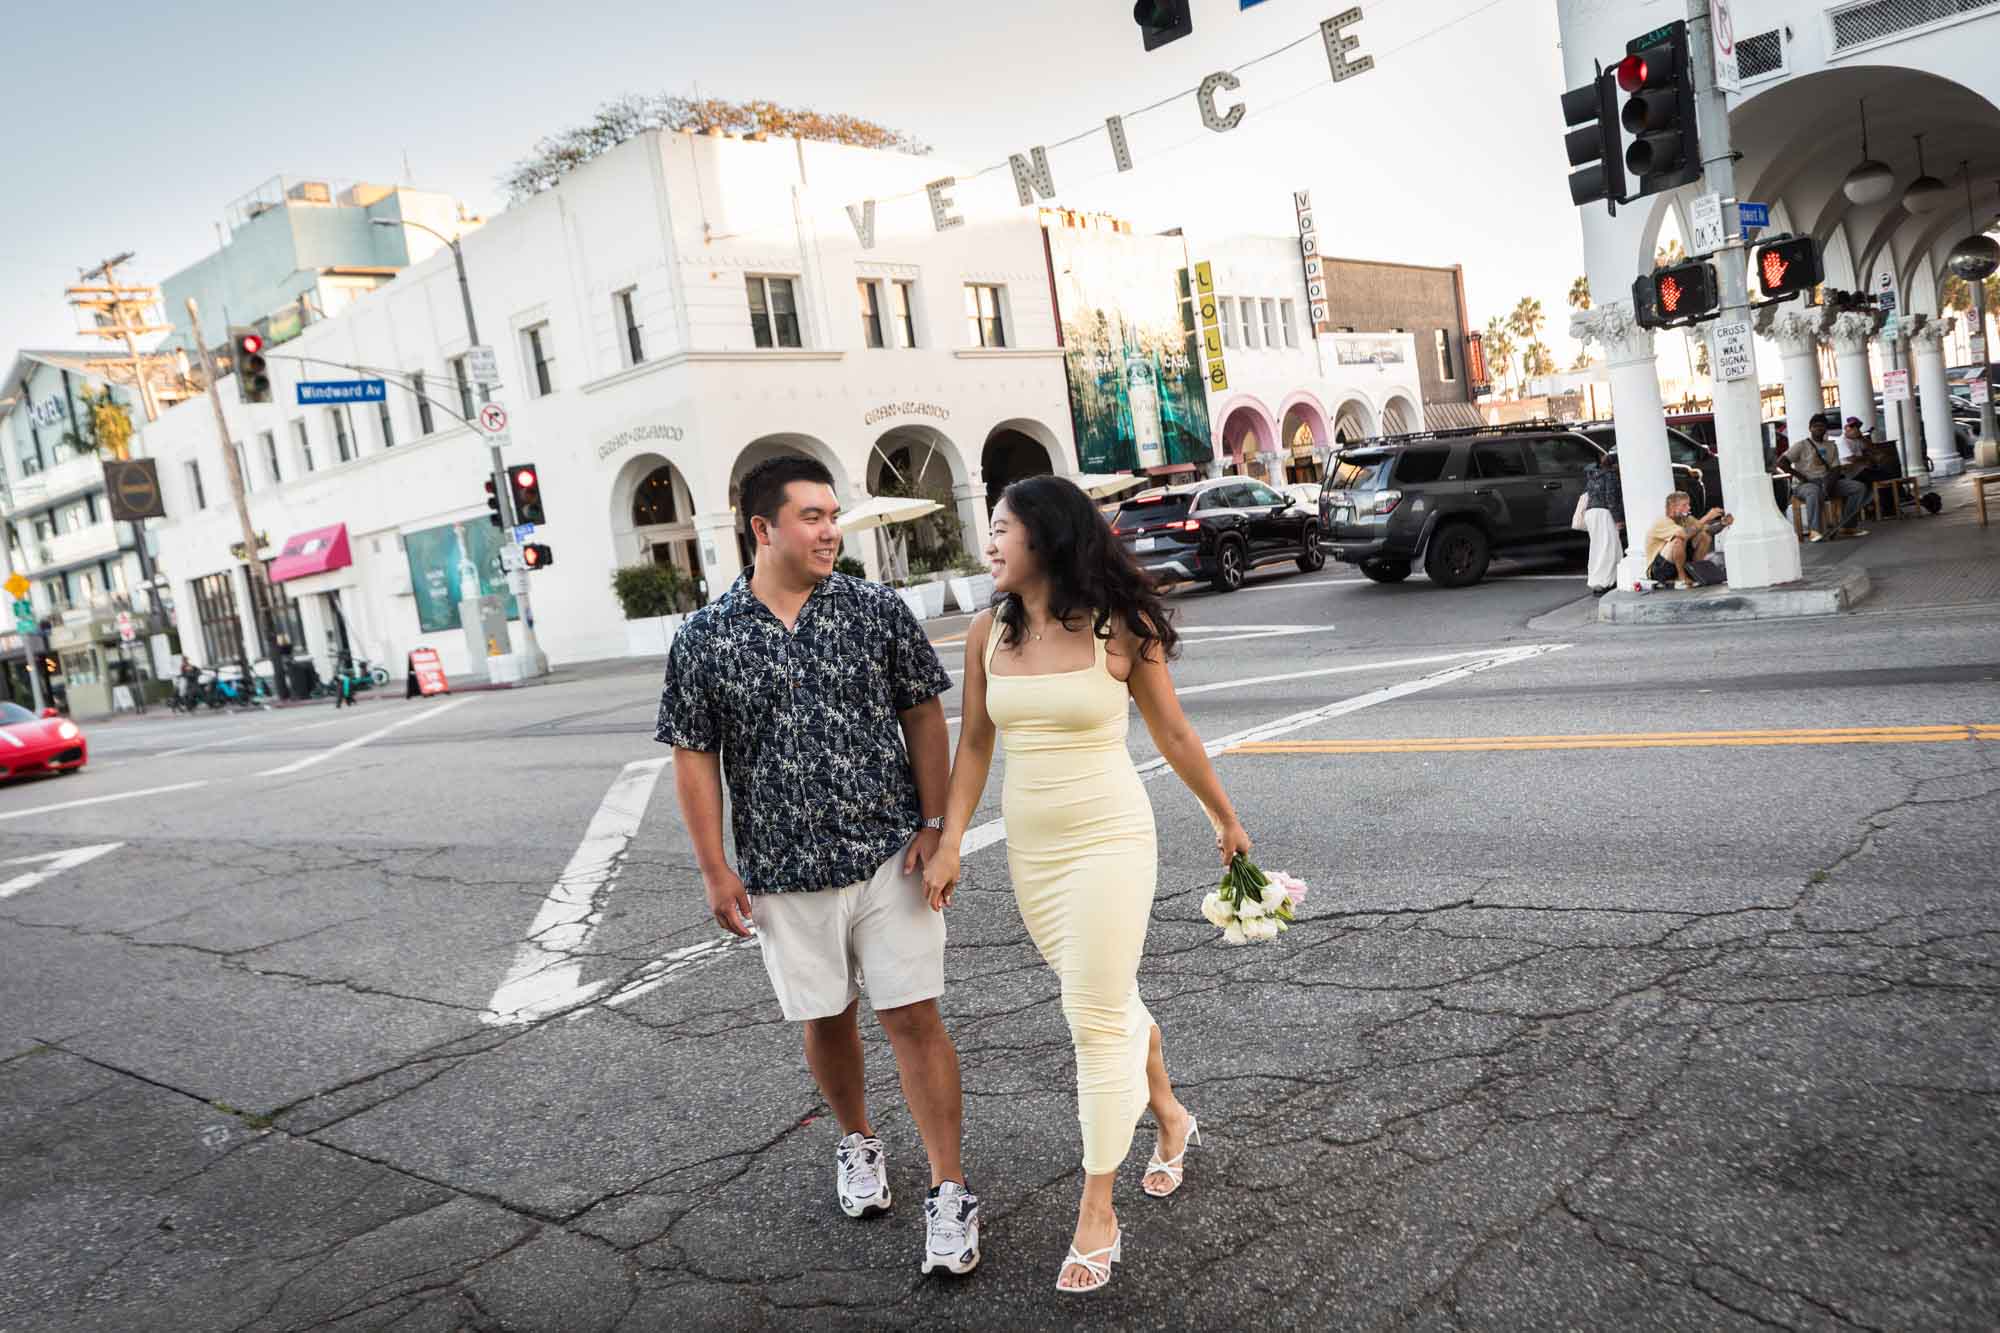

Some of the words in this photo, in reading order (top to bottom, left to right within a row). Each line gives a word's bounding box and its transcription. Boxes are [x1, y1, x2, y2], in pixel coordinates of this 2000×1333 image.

[845, 6, 1375, 248] VENICE
[1299, 193, 1323, 319] VOODOO
[1717, 324, 1745, 337] CROSS
[1728, 337, 1737, 345] ON
[1723, 344, 1745, 355] WALK
[1164, 355, 1191, 369] CASA
[1720, 354, 1749, 367] SIGNAL
[1725, 365, 1746, 377] ONLY
[301, 384, 362, 399] Windward
[366, 383, 380, 396] Av
